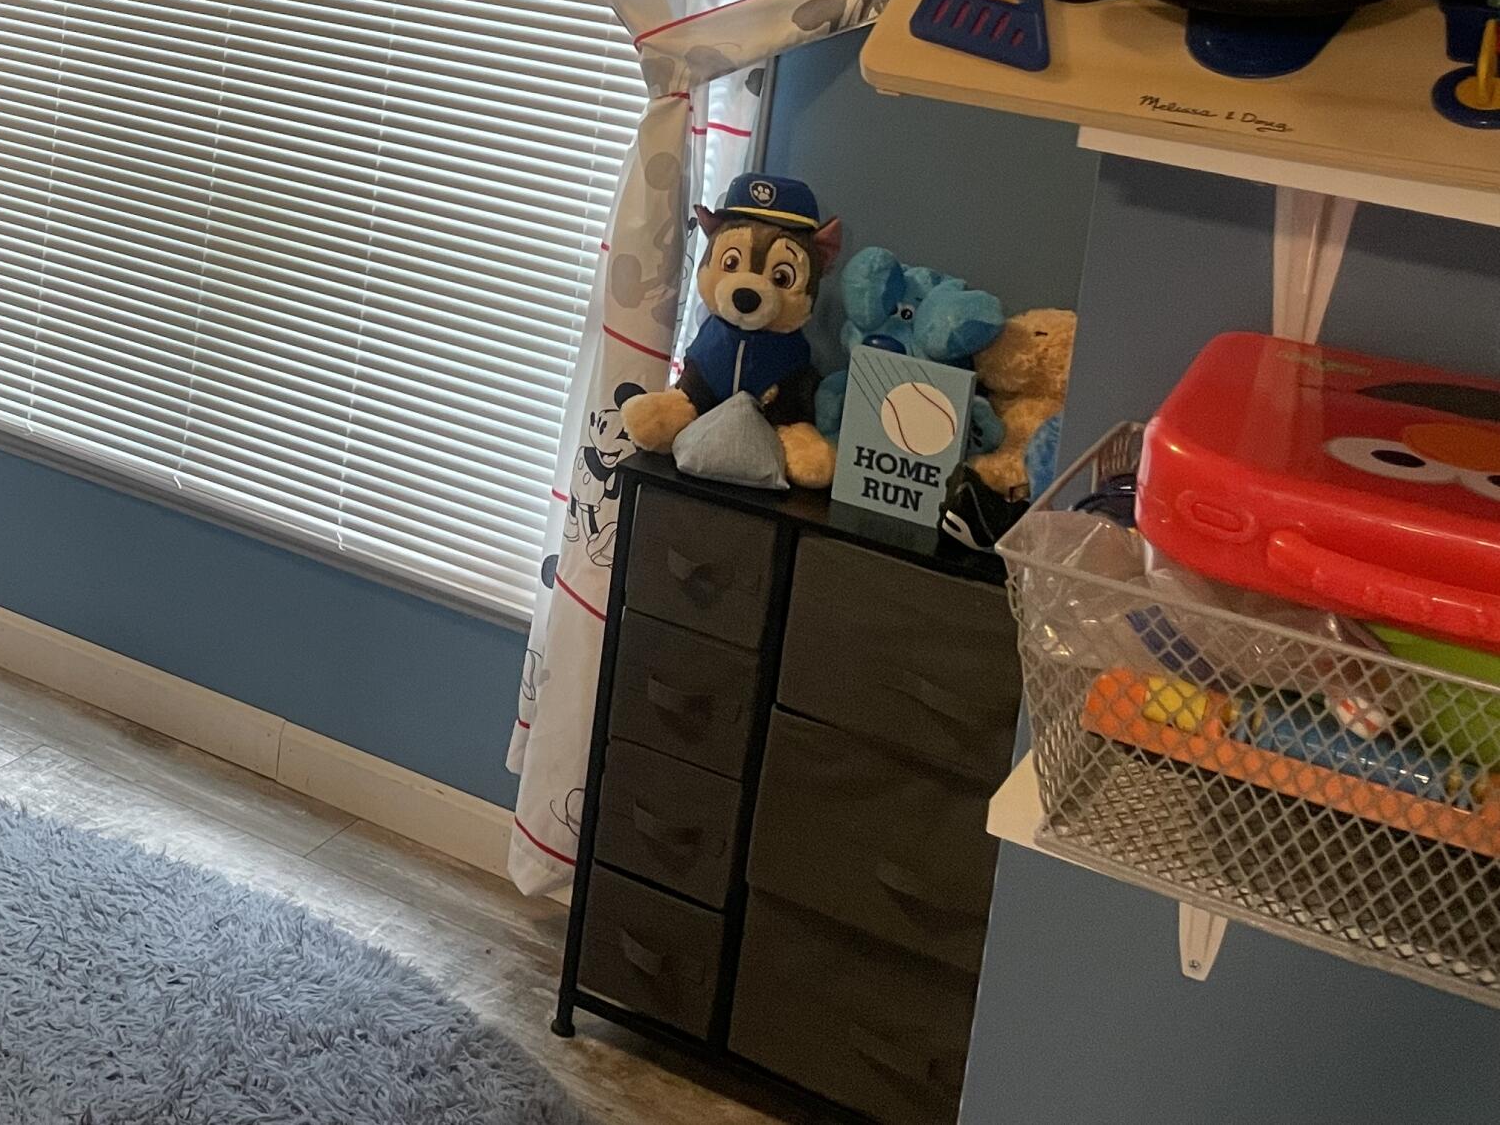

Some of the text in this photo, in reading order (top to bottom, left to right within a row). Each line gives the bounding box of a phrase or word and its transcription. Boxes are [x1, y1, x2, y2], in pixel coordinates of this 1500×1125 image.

[1241, 112, 1293, 132] Doug
[853, 446, 941, 488] HOME
[861, 477, 923, 512] RUN
